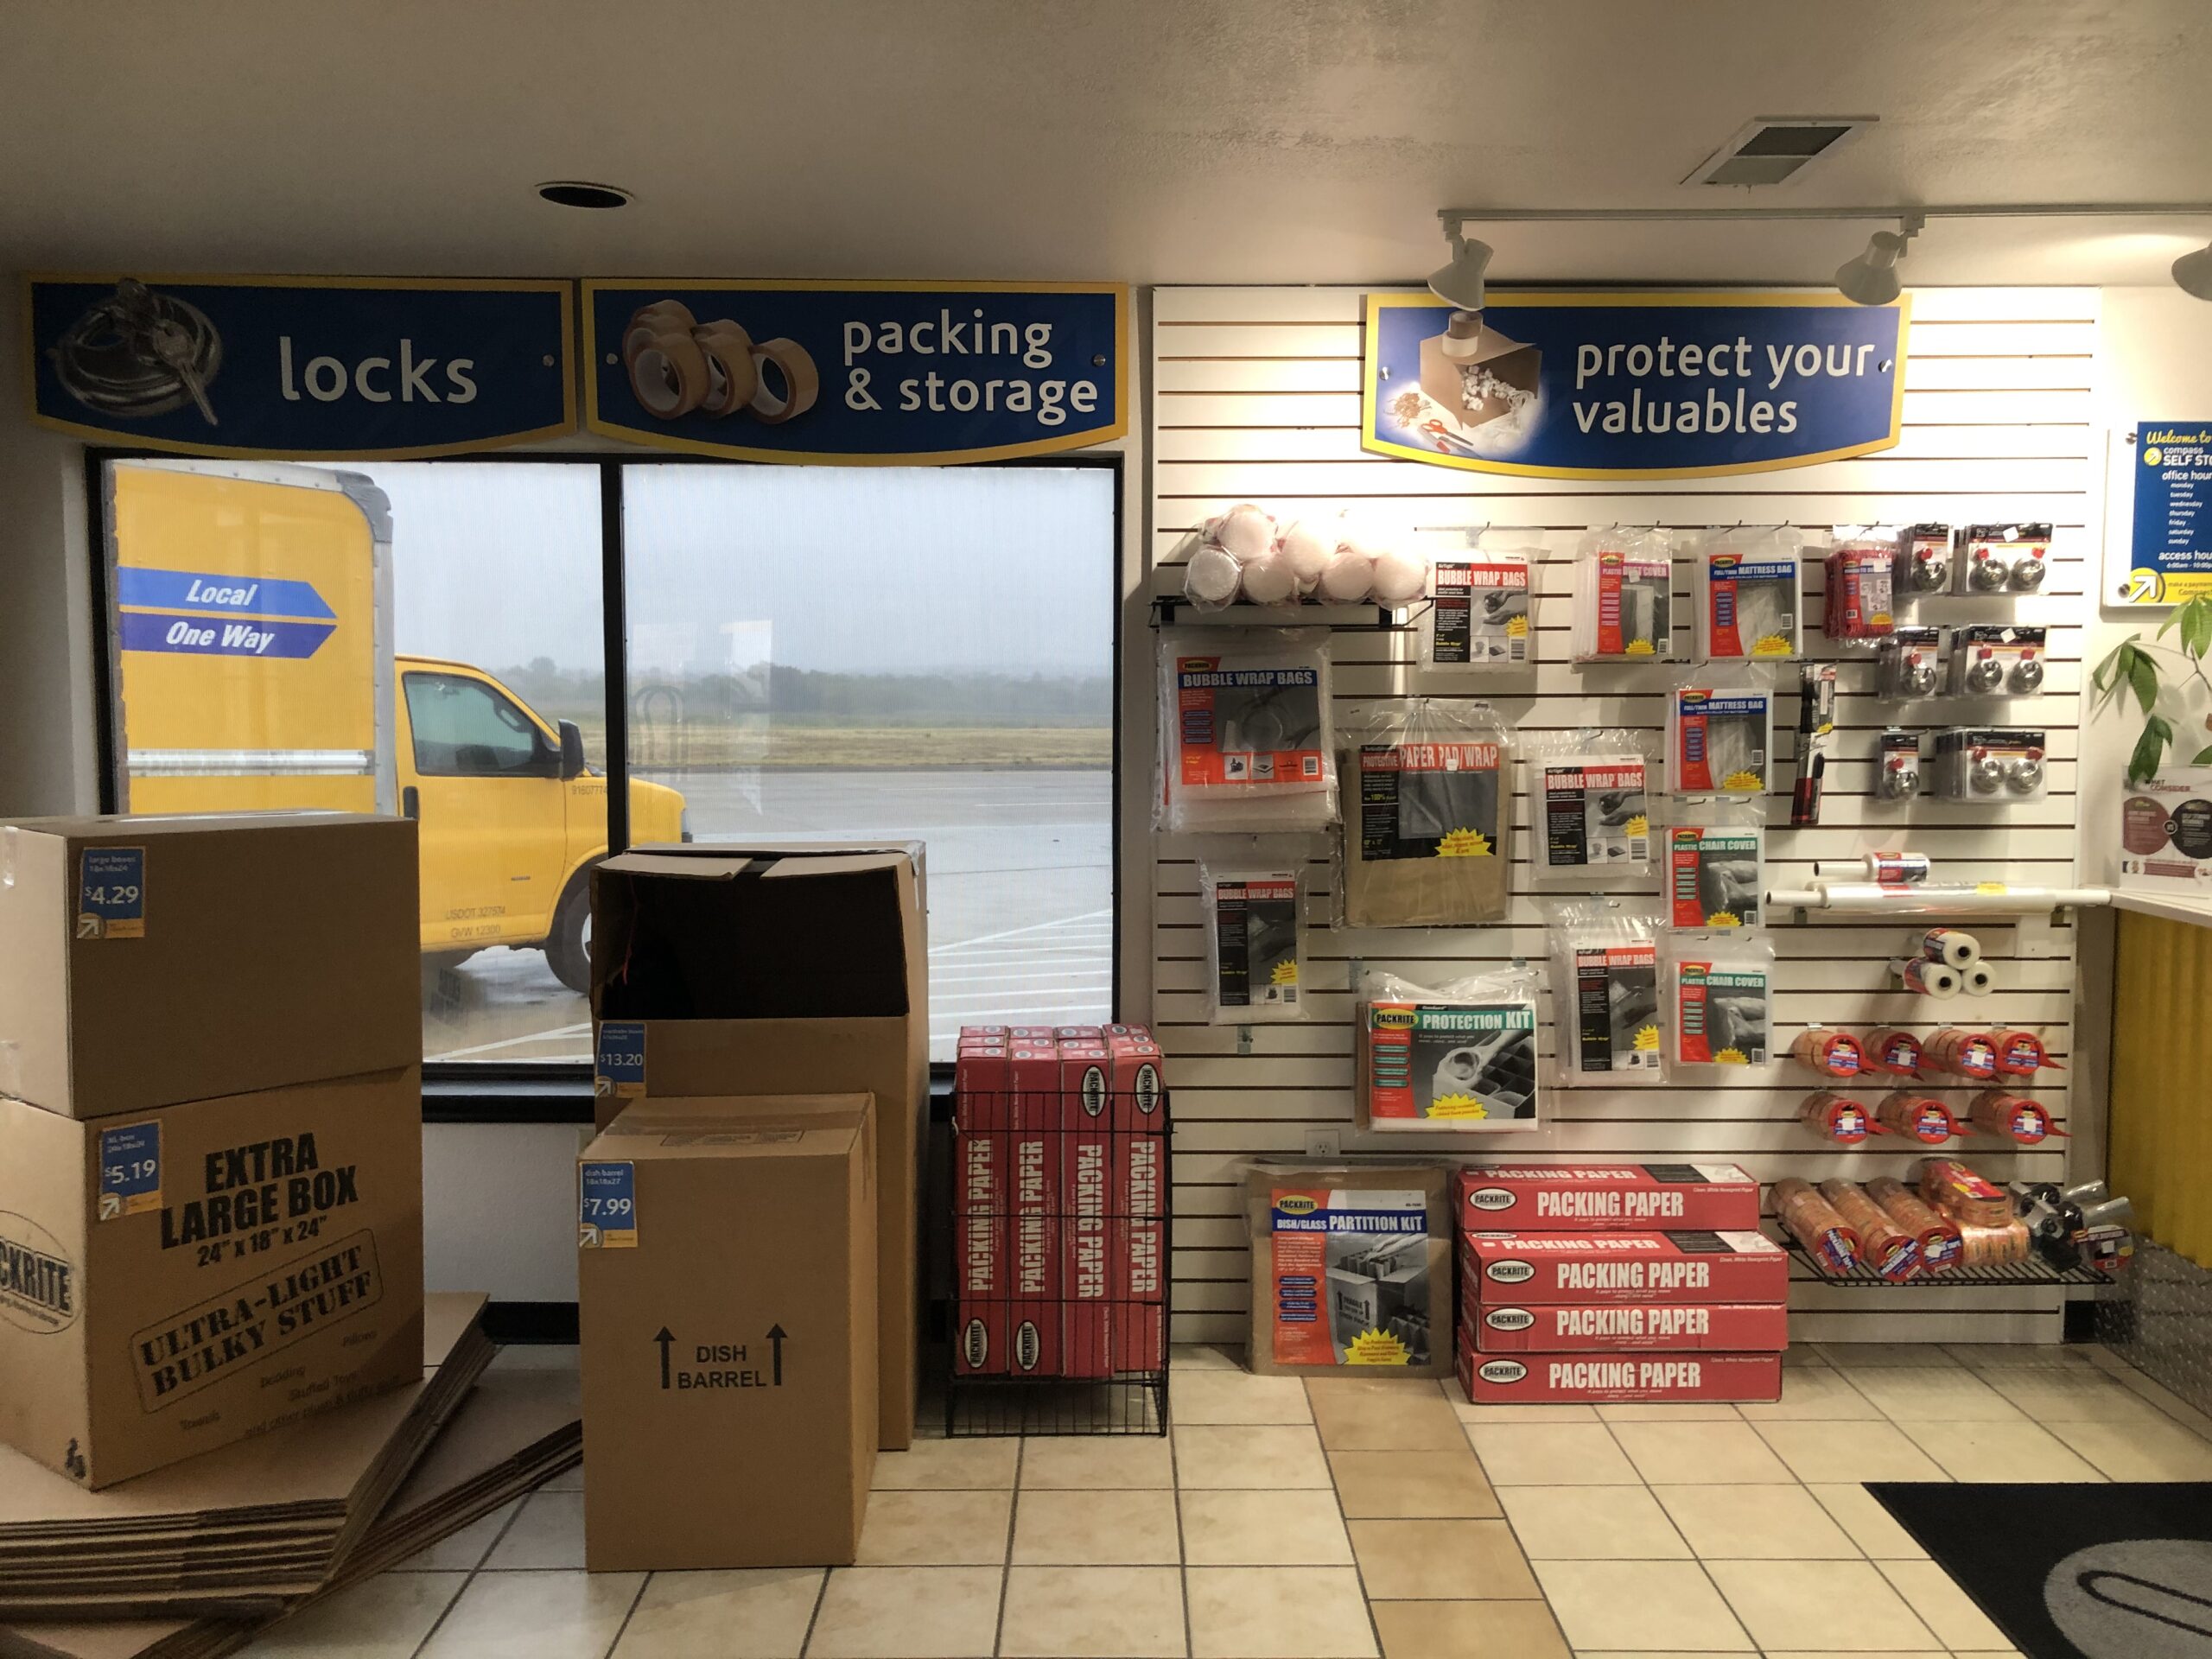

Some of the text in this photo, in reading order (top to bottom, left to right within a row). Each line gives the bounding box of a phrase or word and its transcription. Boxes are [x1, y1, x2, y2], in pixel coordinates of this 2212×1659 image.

[843, 308, 1053, 369] packing
[279, 336, 478, 404] locks
[1576, 337, 1876, 391] protect your
[845, 367, 1098, 426] & storage
[1573, 388, 1798, 435] valuables
[2146, 429, 2212, 444] Welcome to
[2163, 454, 2193, 466] SELF
[2164, 448, 2203, 456] compass
[2162, 470, 2189, 480] office
[1438, 570, 1526, 587] BUBBLE WRAP BAGS
[1643, 567, 1667, 576] COVER
[1738, 566, 1776, 575] MATTRESS
[187, 579, 259, 607] Local
[165, 622, 275, 654] One Way
[1183, 671, 1313, 688] BUBBLE WRAP BAGS
[1363, 755, 1398, 767] PROTECTIVE
[1399, 746, 1434, 768] PAPER
[1548, 772, 1642, 789] BUBBLE WRAP BAGS
[1699, 841, 1726, 850] CHAIR
[1728, 841, 1756, 849] COVER
[85, 885, 139, 905] $4.29
[1217, 887, 1294, 899] BUBBLE WRAP BAGS
[1578, 954, 1654, 967] BUBBLE WRAP BAGS
[1707, 976, 1733, 985] CHAIR
[1735, 977, 1764, 987] COVER
[1376, 1011, 1530, 1029] PACKRITE PROTECTION KIT
[601, 1053, 643, 1066] $13.20
[105, 1159, 156, 1185] $5.19
[205, 1132, 319, 1193] EXTRA
[1485, 1170, 1637, 1179] PACKING PAPER
[160, 1165, 359, 1249] LARGE BOX
[583, 1198, 632, 1216] $7.99
[1279, 1200, 1314, 1209] PACKRITE
[1475, 1192, 1684, 1217] PACKRITE PACKING PAPER
[968, 1139, 994, 1291] PACKING PAPER
[1020, 1141, 1046, 1293] PACKING PAPER
[1077, 1144, 1103, 1297] PACKING PAPER
[1130, 1141, 1157, 1294] PACKING PAPER
[1277, 1216, 1422, 1230] DISH/GLASS PARTITION KIT
[234, 1239, 246, 1257] x
[283, 1225, 295, 1245] x
[1502, 1240, 1661, 1249] PACKING PAPER
[1491, 1262, 1710, 1289] PACKRITE PACKING PAPER
[140, 1244, 365, 1368] ULTRA-LIGHT
[1491, 1309, 1709, 1336] PACKRITE PACKING PAPER
[151, 1320, 271, 1396] BULKY
[278, 1272, 373, 1336] STUFF
[696, 1344, 747, 1363] DISH
[677, 1370, 767, 1389] BARREL
[1484, 1363, 1701, 1389] PACKRITE PACKING PAPER
